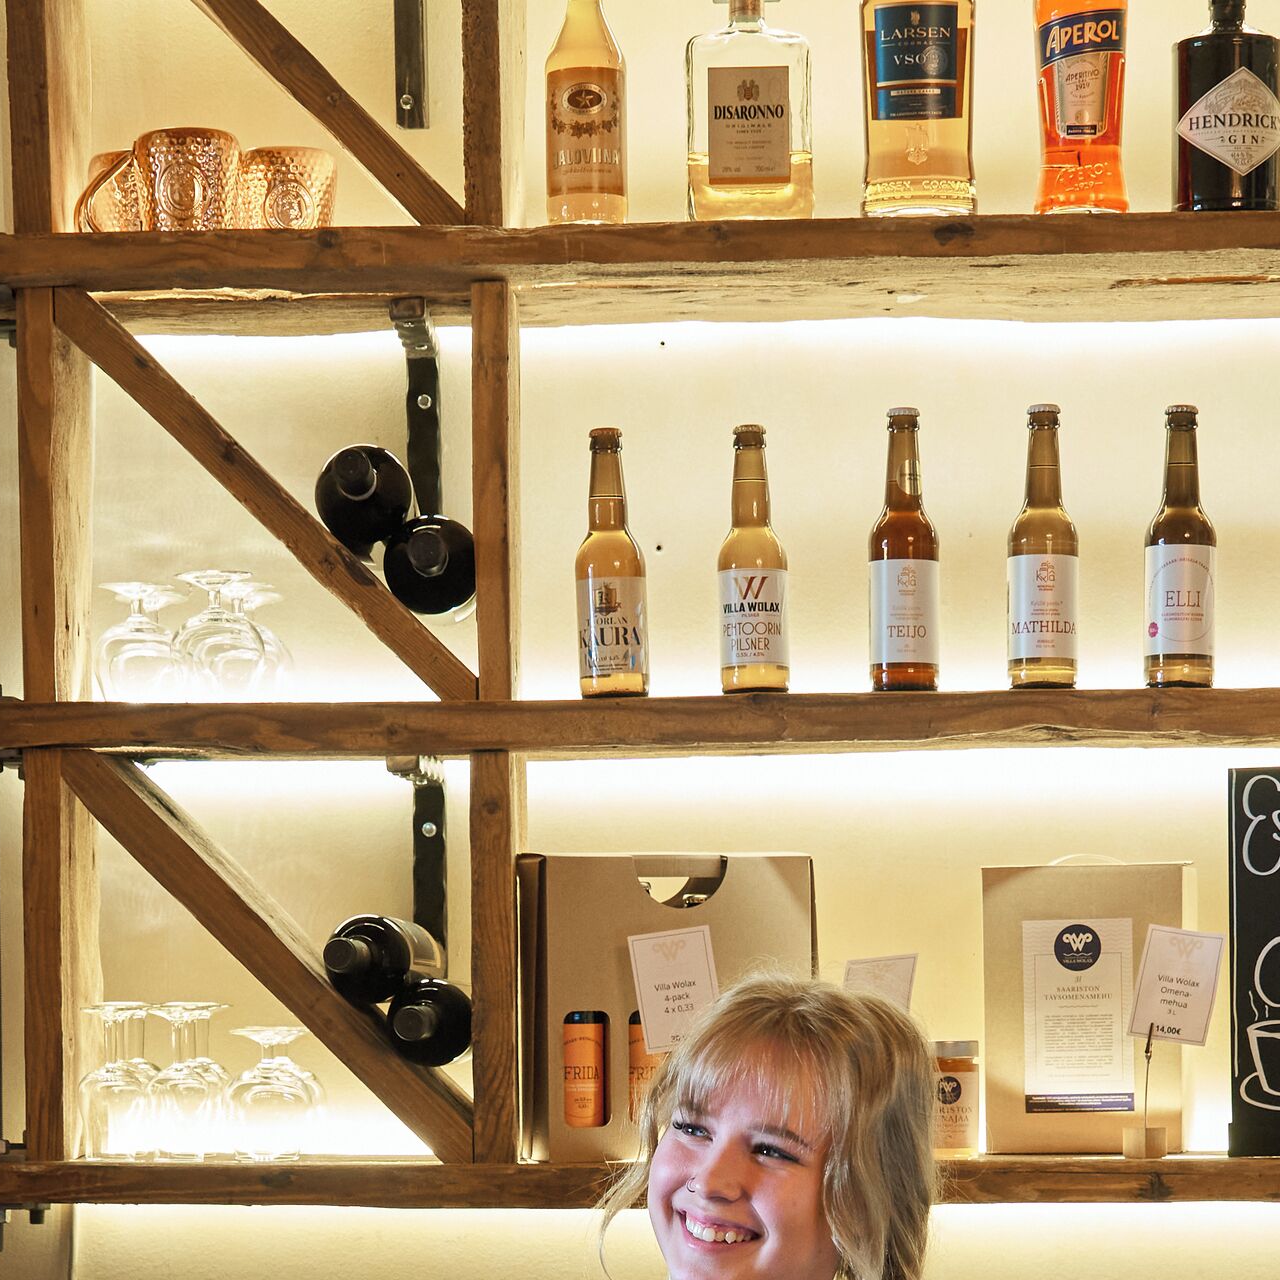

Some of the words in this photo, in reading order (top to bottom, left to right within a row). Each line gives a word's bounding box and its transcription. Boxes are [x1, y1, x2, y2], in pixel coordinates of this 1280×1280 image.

[880, 26, 951, 41] LARSEN
[1045, 19, 1120, 58] APEROL
[1065, 68, 1099, 82] APERITIVO
[713, 104, 784, 121] DISARONNO
[1228, 134, 1259, 144] GIN
[553, 147, 620, 169] JALOVIINA
[1165, 590, 1201, 607] ELLI
[722, 601, 746, 614] VILLA
[747, 601, 780, 613] WOLAX
[887, 625, 927, 638] TEIJO
[1011, 620, 1076, 635] MATHILDA
[579, 626, 641, 649] KAURA
[731, 637, 770, 651] PILSNER
[654, 983, 671, 992] Villa
[672, 979, 697, 989] Wolax
[1157, 974, 1174, 983] Villa
[1176, 977, 1200, 987] Wolax
[1056, 985, 1101, 993] SAARISTON
[1160, 986, 1193, 998] Omena-
[664, 992, 690, 1003] 4-pack
[1160, 998, 1188, 1009] mehua
[1156, 1025, 1182, 1036] 14,00€
[563, 1065, 600, 1080] FRIDA
